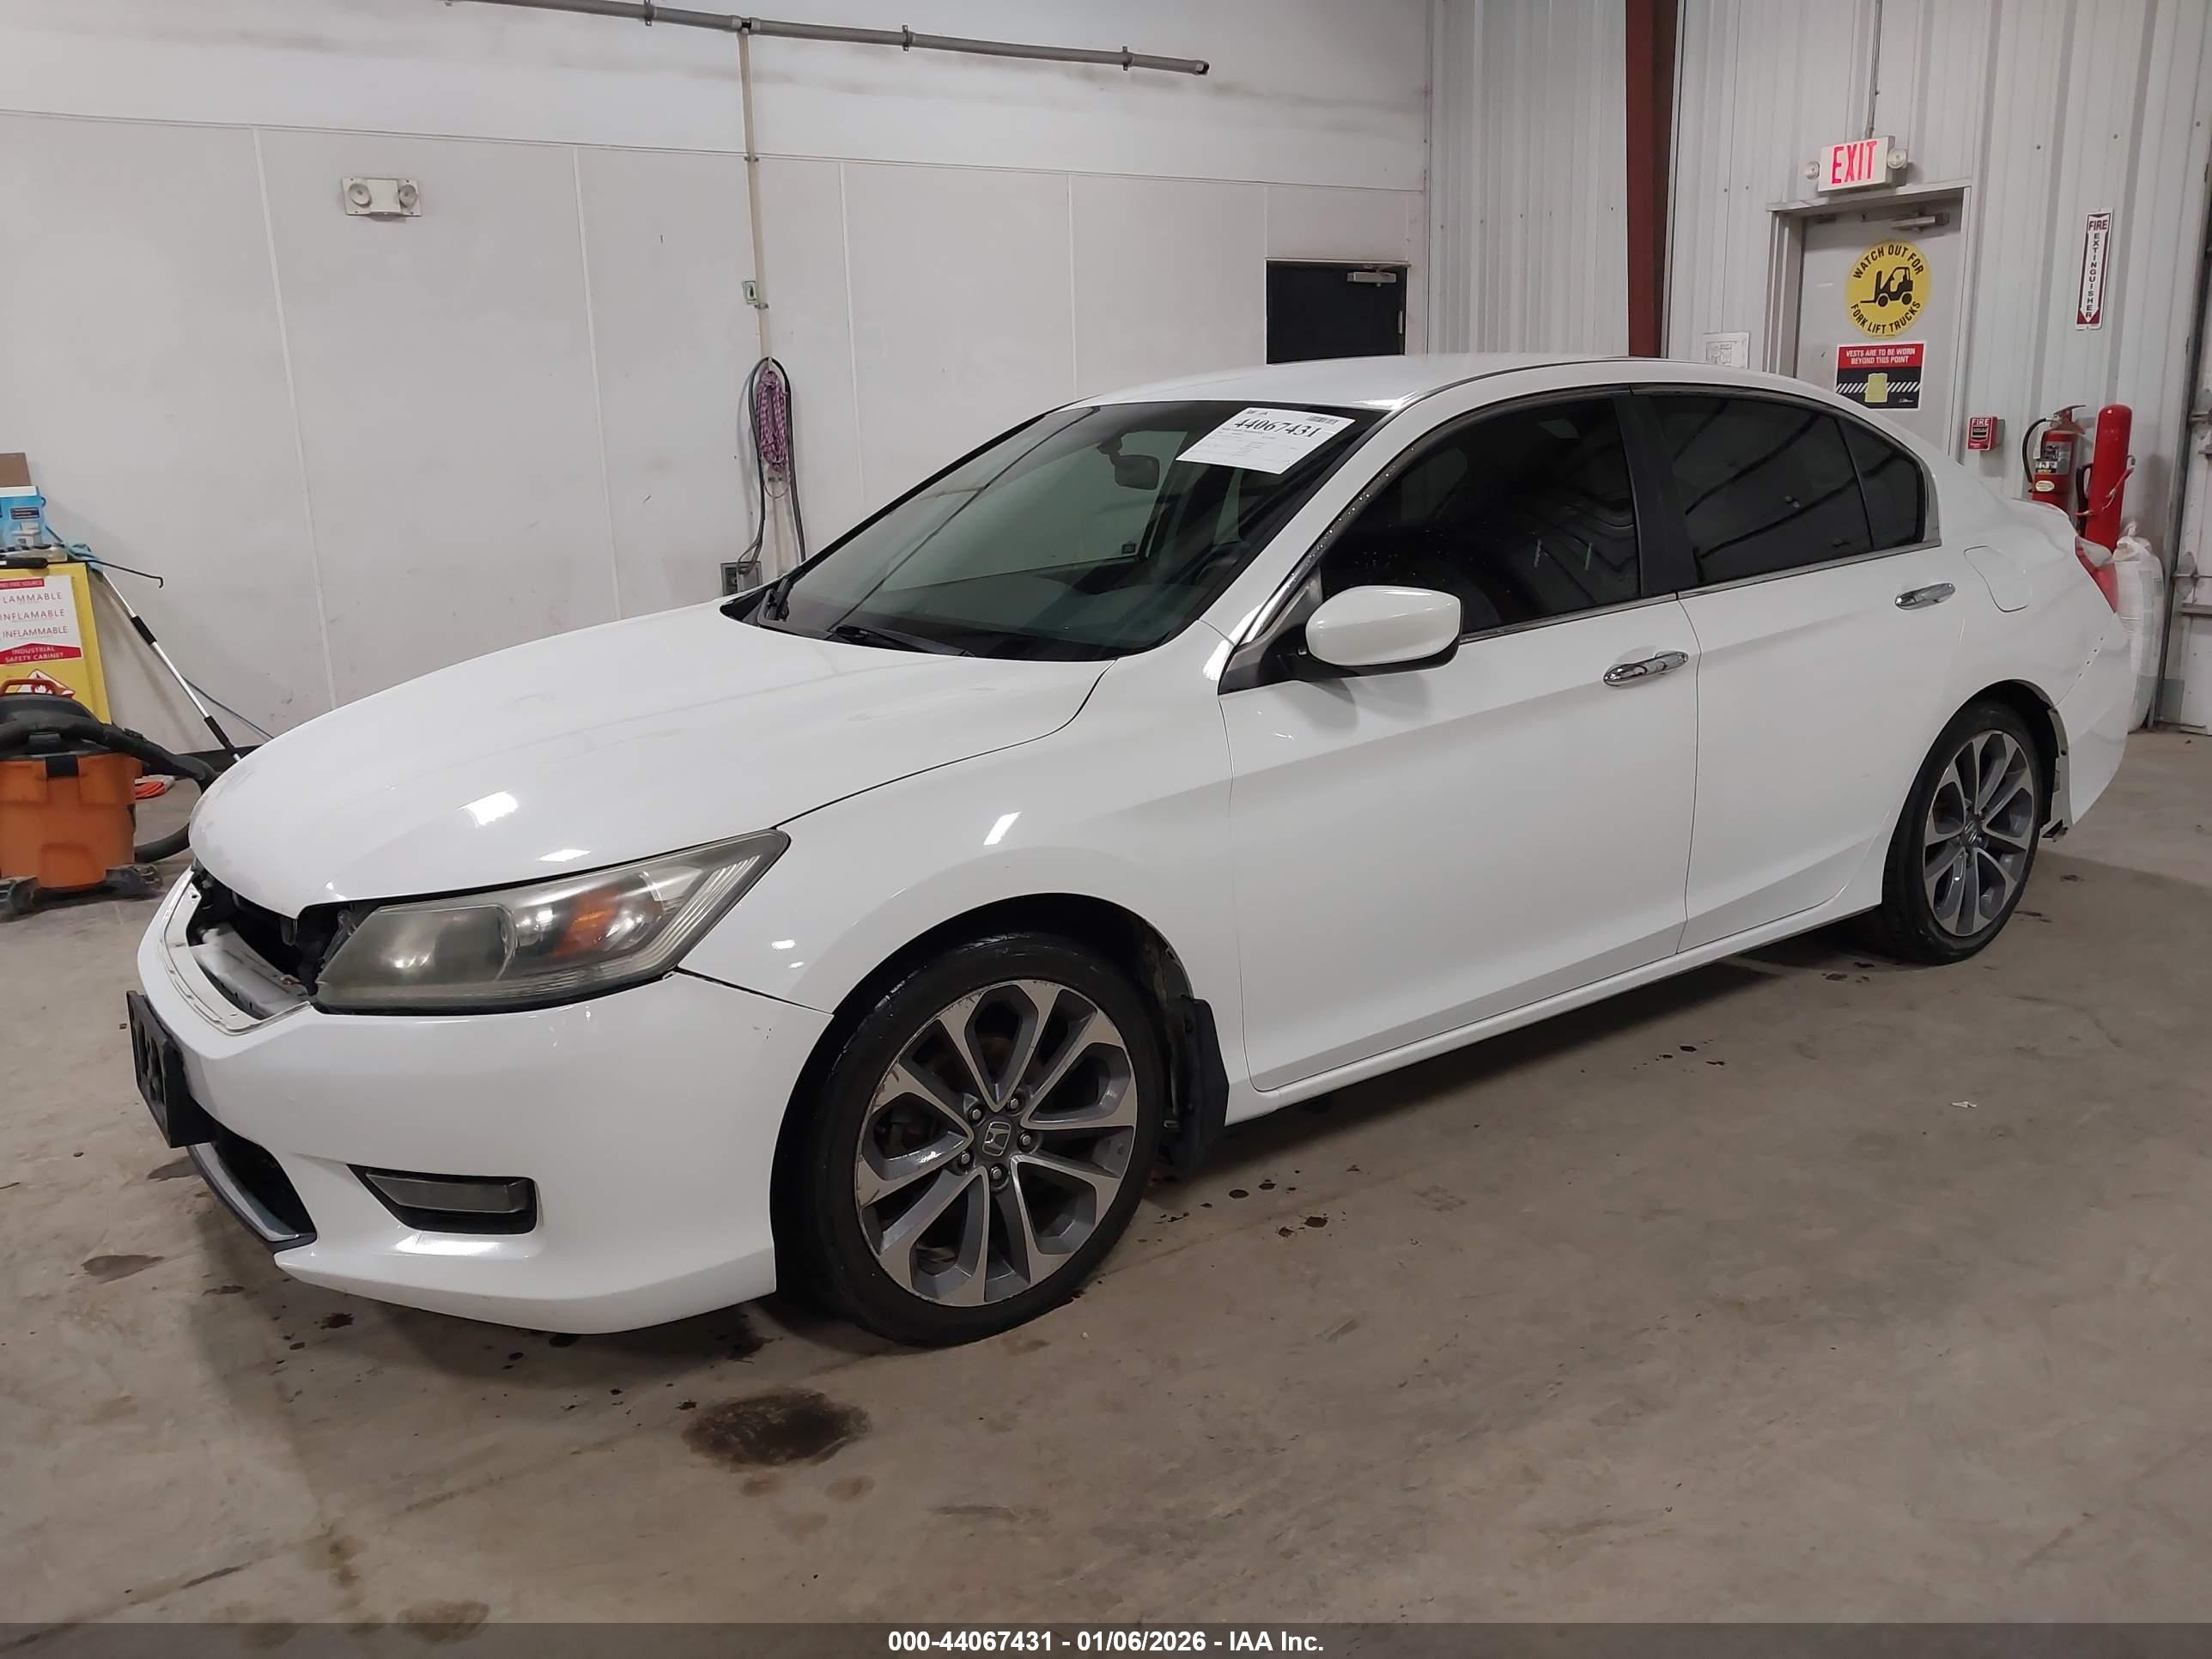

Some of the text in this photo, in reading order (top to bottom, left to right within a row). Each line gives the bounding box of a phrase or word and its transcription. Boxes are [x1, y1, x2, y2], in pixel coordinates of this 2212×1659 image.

[1831, 140, 1878, 185] EXIT
[2088, 219, 2108, 231] FIRE
[1852, 244, 1924, 279] WATCH OUT FOR
[2085, 232, 2100, 319] EXTINGUISHER
[1850, 301, 1921, 334] FORK LIFT TRUCKS
[1845, 349, 1864, 357] VESTS
[1896, 347, 1916, 356] WORN
[1850, 356, 1875, 365] BEYOND
[1233, 417, 1322, 438] 44067431
[3, 592, 63, 604] LAMMABLE
[0, 608, 65, 621] INFLAMABLE
[2, 625, 69, 638] INFLAMMABLE
[11, 646, 56, 654] INDUSTRIAL
[5, 654, 31, 663] SAFETY
